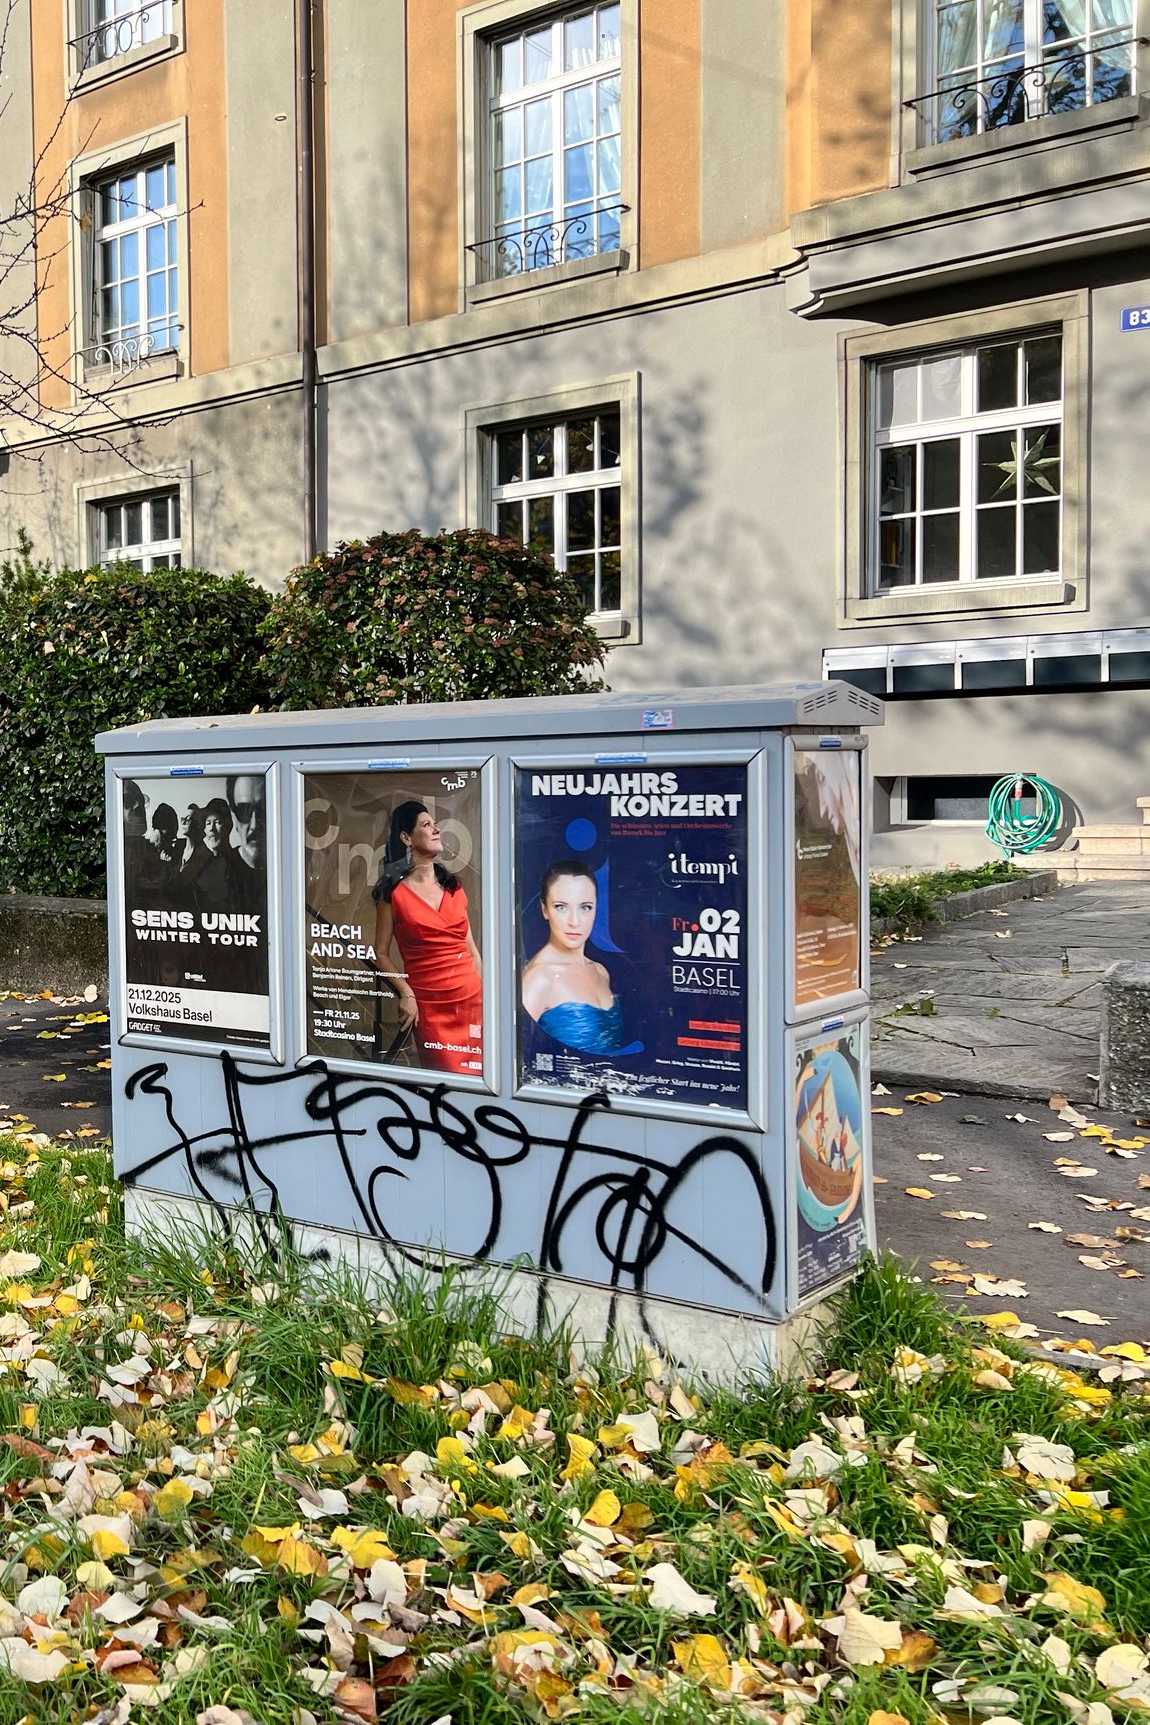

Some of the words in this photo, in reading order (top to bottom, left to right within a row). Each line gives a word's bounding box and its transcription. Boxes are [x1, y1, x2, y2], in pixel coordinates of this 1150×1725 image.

[1130, 309, 1150, 326] 83
[440, 776, 466, 791] cmb
[532, 772, 678, 796] NEUJAHRS
[610, 794, 742, 818] KONZERT
[131, 910, 194, 929] SENS
[201, 912, 262, 932] UNIK
[136, 929, 200, 944] WINTER
[208, 933, 258, 947] TOUR
[310, 923, 362, 940] BEACH
[310, 942, 344, 958] AND
[347, 944, 377, 960] SEA
[672, 932, 739, 959] JAN
[342, 968, 375, 976] Baumgartner,
[672, 966, 741, 988] BASEL
[128, 988, 182, 1004] 21.12.2025
[674, 986, 709, 994] Stadtcasino
[129, 1002, 182, 1019] Volkshaus
[183, 1008, 213, 1022] Basel
[324, 1009, 334, 1018] FR
[334, 1010, 360, 1020] 21.11.25
[129, 1022, 154, 1032] GADGET
[314, 1018, 332, 1027] 19:30
[333, 1020, 346, 1028] Uhr
[314, 1028, 356, 1040] Stadtcasino
[356, 1033, 376, 1043] Basel
[424, 1042, 482, 1054] cmb-basel.ch
[638, 1074, 670, 1085] festlicher
[670, 1078, 688, 1086] Start
[720, 1084, 740, 1092] Jahr!
